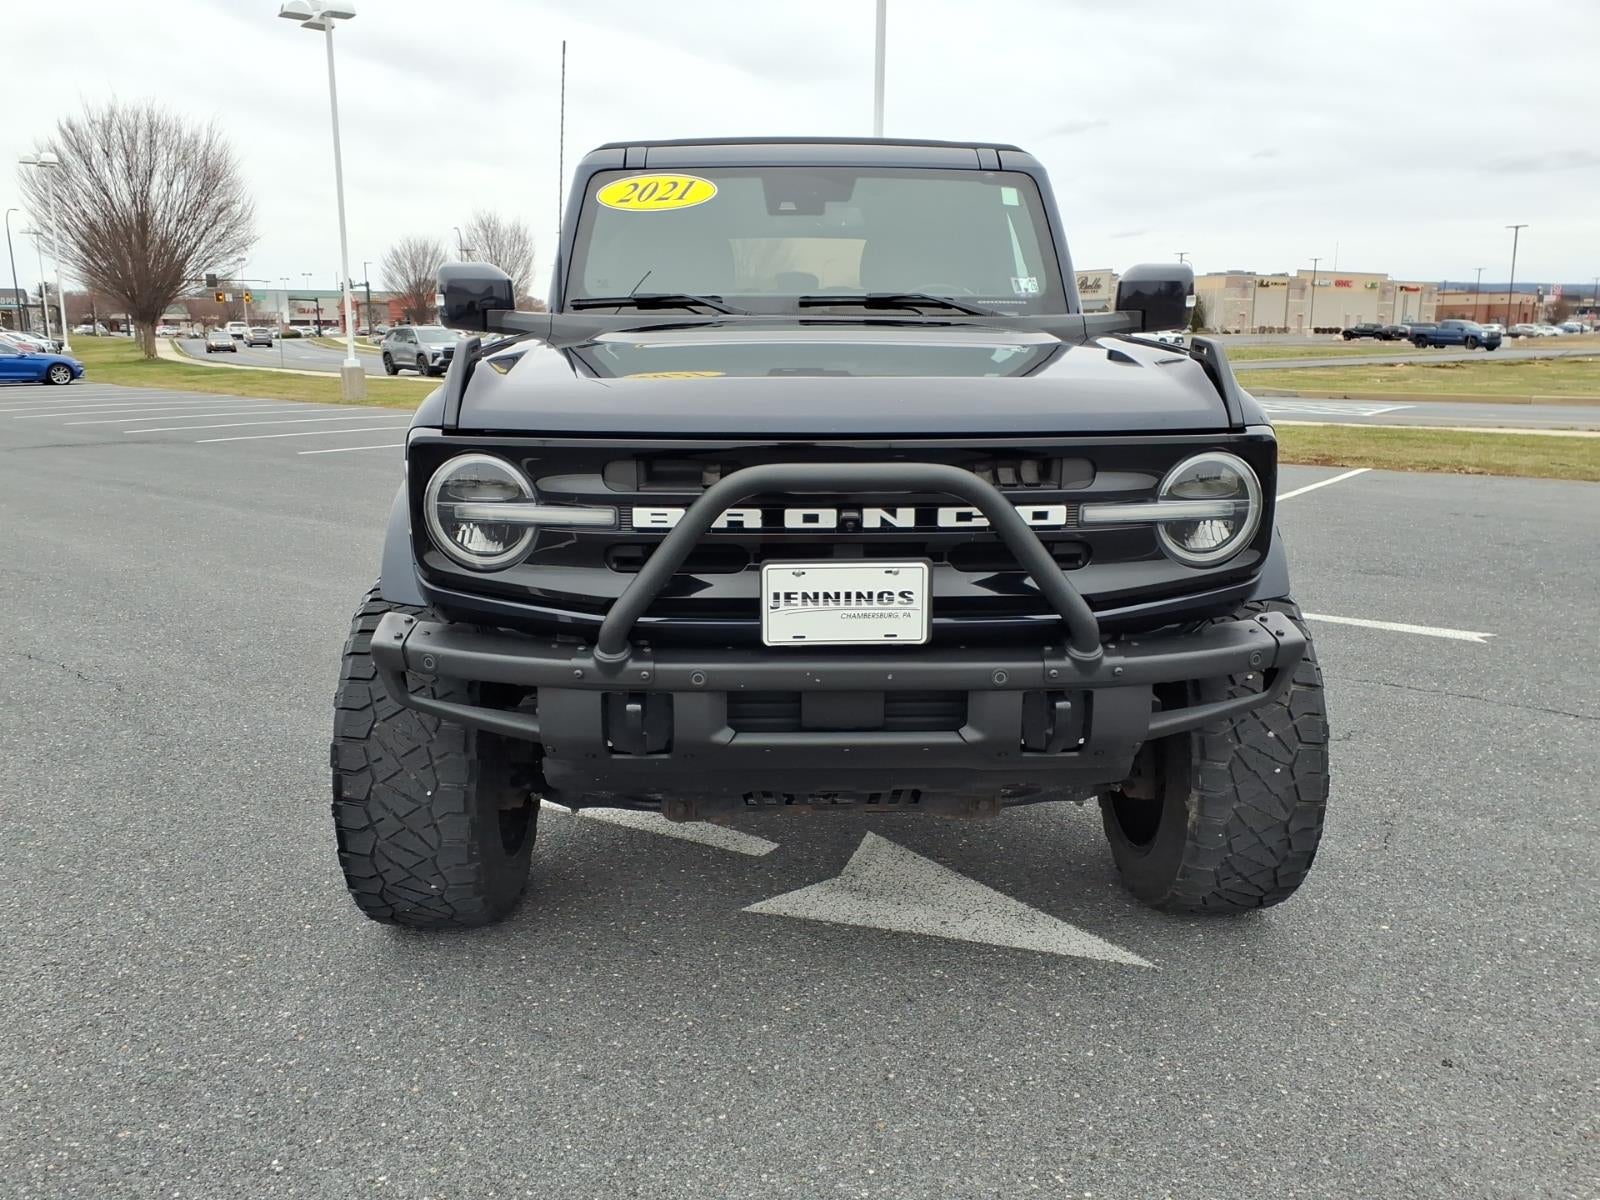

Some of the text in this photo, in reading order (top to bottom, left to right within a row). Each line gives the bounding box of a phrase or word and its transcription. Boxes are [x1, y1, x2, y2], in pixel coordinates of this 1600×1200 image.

[616, 180, 696, 203] 2021
[6, 297, 24, 305] PIZA
[632, 506, 1067, 530] BRONCO
[770, 590, 915, 609] JENNINGS
[840, 611, 912, 620] CHAMBERSBURG, PA
